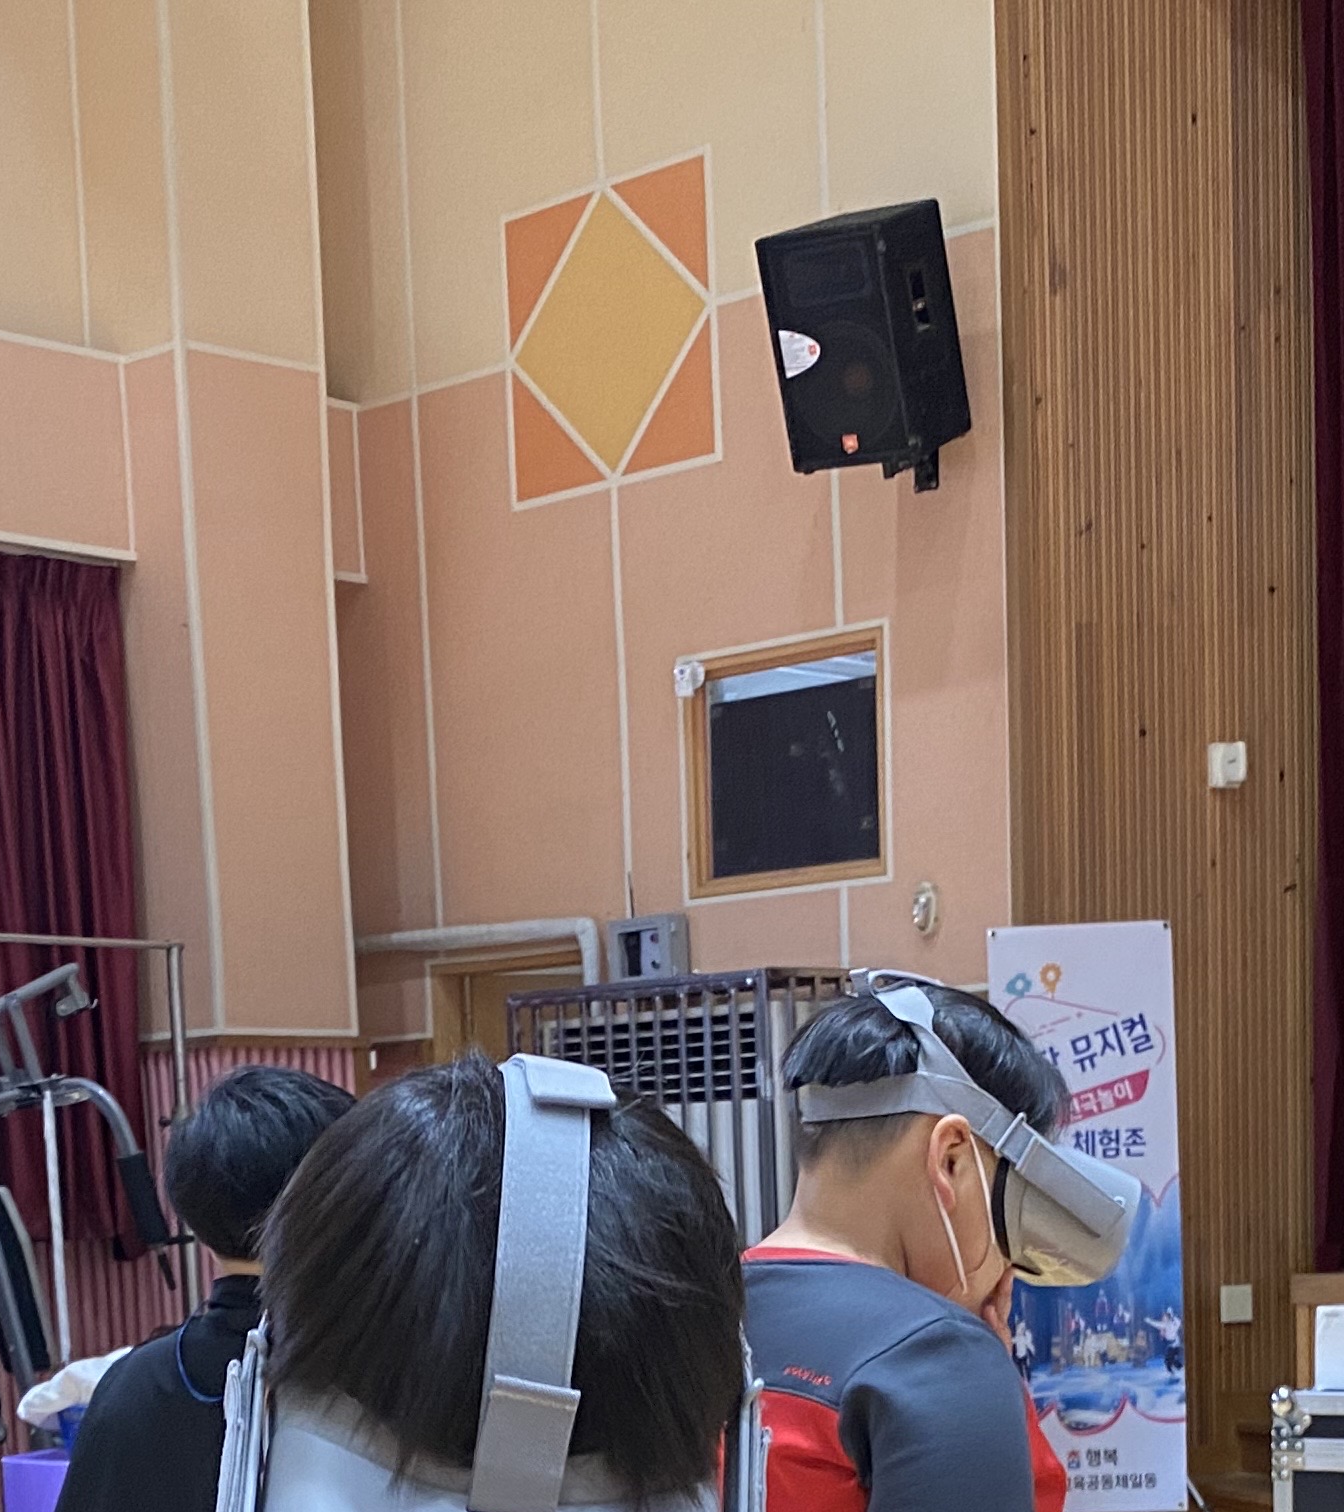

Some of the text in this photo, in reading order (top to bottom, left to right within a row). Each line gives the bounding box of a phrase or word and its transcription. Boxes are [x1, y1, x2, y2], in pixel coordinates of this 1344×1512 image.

[1070, 1013, 1154, 1072] 뮤지컬
[1073, 1128, 1146, 1158] 체험존
[1086, 1448, 1118, 1467] 행복
[1067, 1473, 1156, 1491] 육공동체일동
